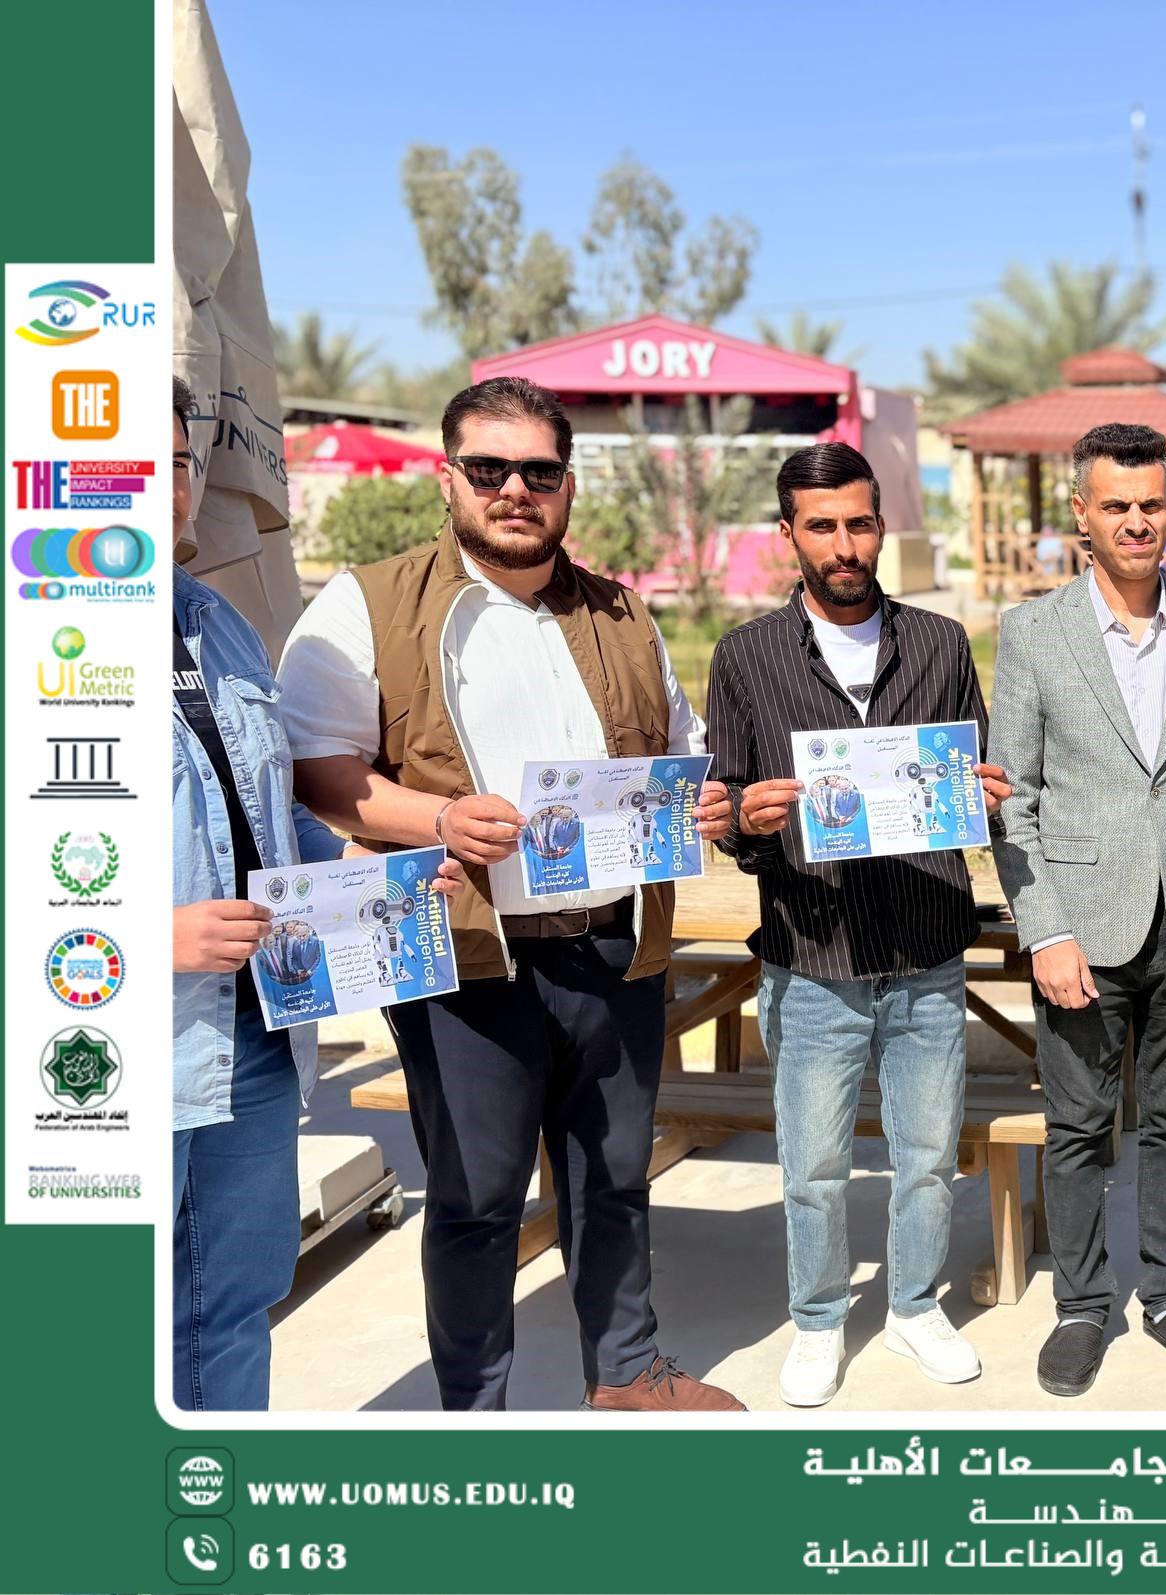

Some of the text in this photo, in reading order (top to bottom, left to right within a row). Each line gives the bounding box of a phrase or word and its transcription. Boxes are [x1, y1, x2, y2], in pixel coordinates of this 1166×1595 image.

[603, 339, 717, 379] JORY
[683, 782, 697, 845] Artificial
[948, 758, 967, 840] Intelligence
[961, 752, 979, 816] Artificial
[668, 786, 683, 872] Intelligence
[416, 890, 436, 988] Intelligence
